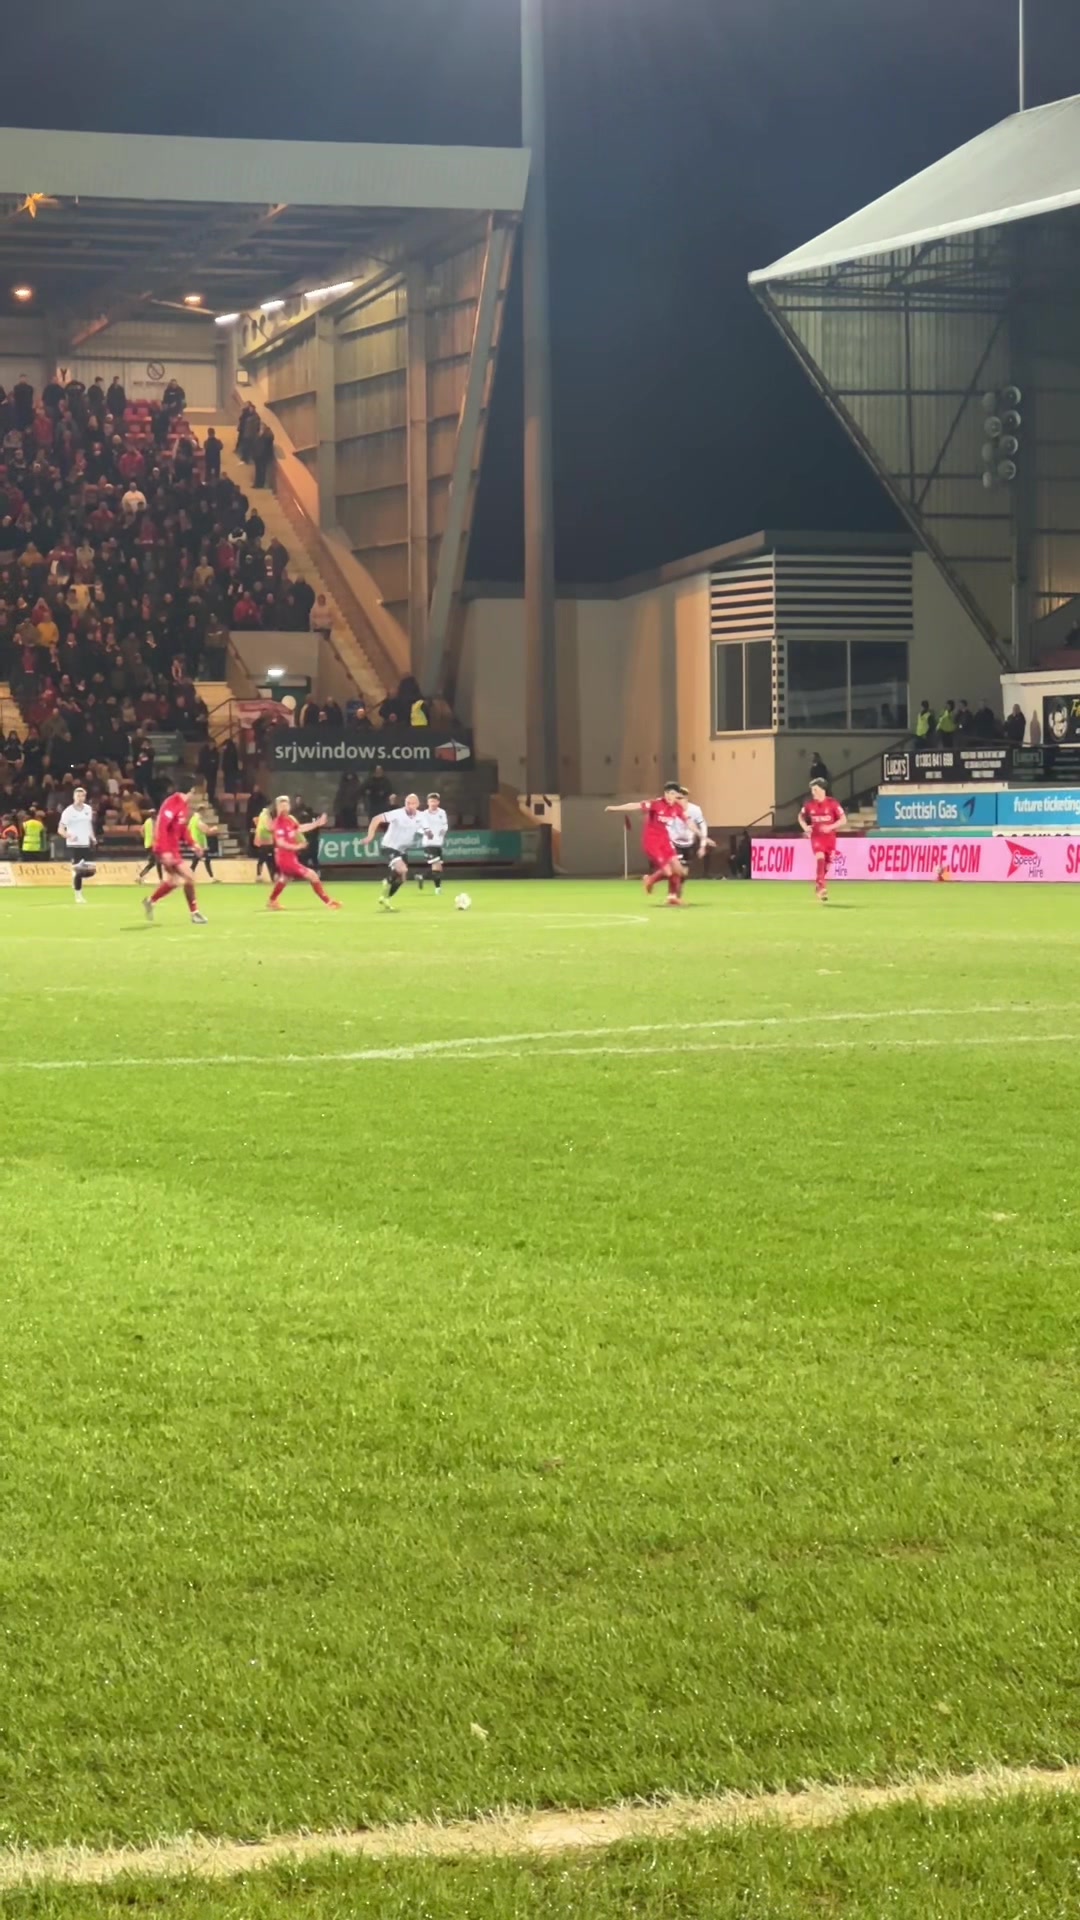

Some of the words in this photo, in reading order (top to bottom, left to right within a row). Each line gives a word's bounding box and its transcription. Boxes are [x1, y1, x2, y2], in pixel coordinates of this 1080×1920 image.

[275, 741, 431, 763] srjwindows.com
[894, 800, 937, 820] Scottish
[938, 799, 958, 819] Gas
[1013, 796, 1043, 812] future
[868, 844, 982, 873] SPEEDYHIRE.COM
[1013, 851, 1042, 868] Speedy
[17, 864, 56, 877] John
[1028, 866, 1043, 878] Hire
